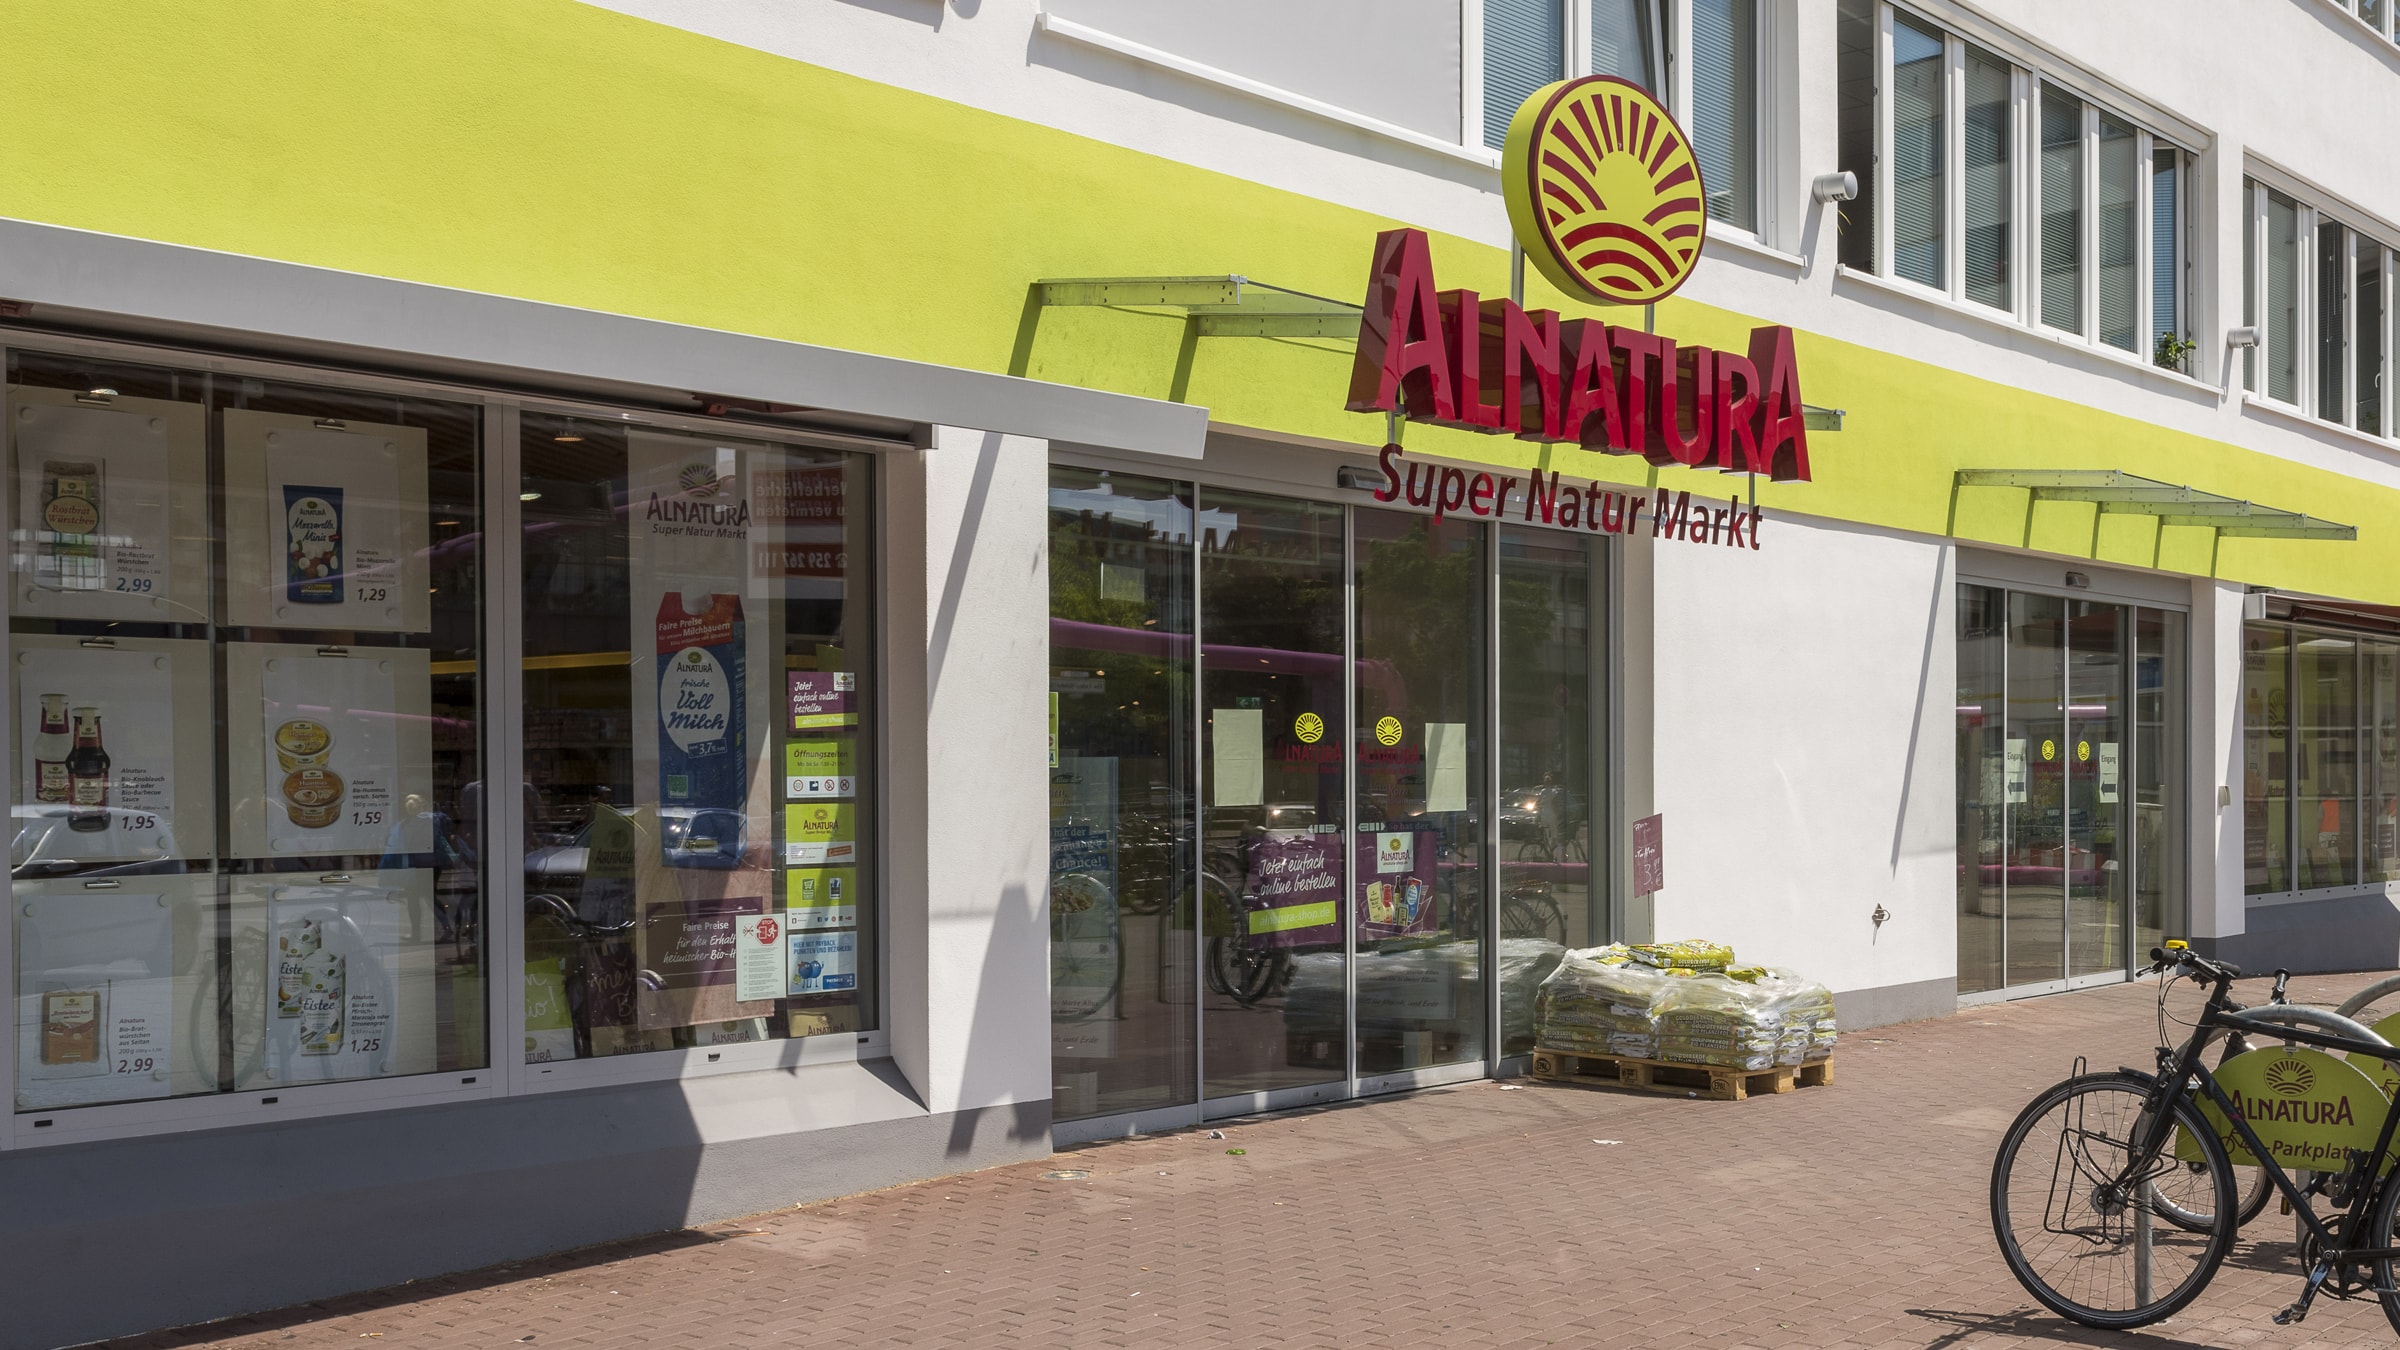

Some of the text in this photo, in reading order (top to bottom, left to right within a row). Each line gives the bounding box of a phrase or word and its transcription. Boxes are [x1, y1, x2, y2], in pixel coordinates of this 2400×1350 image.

[1344, 228, 1811, 484] ALNATURA
[1373, 443, 1763, 551] Super Natur Markt
[52, 504, 91, 515] Rostbrat
[647, 491, 752, 528] ALNATURA
[48, 514, 96, 525] Würstchen
[652, 523, 747, 541] Super Natur Markt
[116, 578, 152, 592] 2,99
[357, 588, 387, 603] 1,29
[658, 616, 704, 632] Faire Preise
[683, 621, 731, 637] Milchbauern
[676, 662, 713, 673] ALNATURA
[680, 678, 710, 689] frische
[794, 681, 813, 692] Jetzt
[676, 690, 714, 710] Voll
[794, 691, 818, 703] einfach
[667, 711, 724, 730] Milch
[794, 748, 848, 760] Öffnungszeiten
[2007, 750, 2024, 762] Eingang
[2100, 754, 2117, 765] Eingang
[121, 776, 166, 784] Bio-Knoblauch
[122, 815, 156, 832] 1,95
[352, 812, 382, 827] 1,59
[803, 820, 839, 831] ALNATURA
[1381, 849, 1410, 862] ALNATURA
[1259, 850, 1325, 877] Jetzt einfach
[1260, 871, 1337, 896] online bestellen
[683, 920, 729, 932] Faire Preise
[676, 932, 736, 951] für den Erhalt
[663, 948, 736, 965] heimischer Bio-H
[281, 961, 302, 976] Eiste
[303, 998, 336, 1012] Eistee
[119, 1033, 152, 1041] würstchen
[131, 1039, 151, 1047] Seitan
[352, 1039, 381, 1054] 1,25
[525, 1047, 553, 1063] ATURA
[117, 1058, 154, 1075] 2,99
[2229, 1089, 2354, 1127] ALNATURA
[2265, 1139, 2351, 1163] -Parkplat
